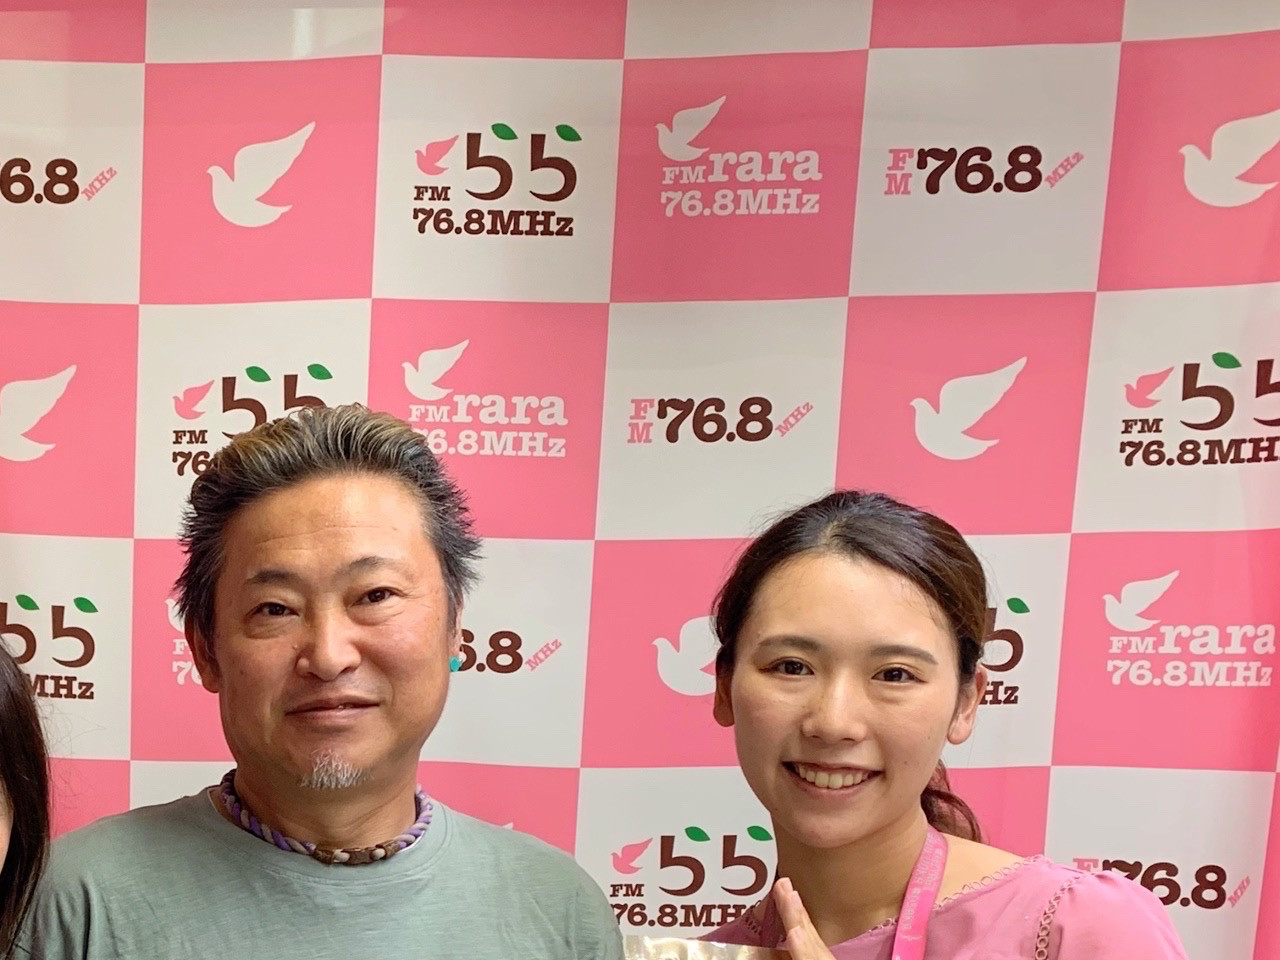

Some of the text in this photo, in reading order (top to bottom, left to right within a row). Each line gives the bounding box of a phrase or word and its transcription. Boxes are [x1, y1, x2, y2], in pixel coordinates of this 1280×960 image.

[662, 148, 823, 184] FM rara
[916, 144, 1043, 195] 76.8
[1043, 150, 1084, 188] MHz
[80, 165, 117, 202] MHz
[413, 185, 451, 202] FM
[660, 188, 821, 218] 76.8MHz
[412, 207, 574, 238] 76.8MHz
[408, 394, 568, 426] FM rara
[656, 396, 773, 444] 76.8
[774, 401, 814, 438] MHz
[172, 430, 208, 444] FM
[1121, 418, 1163, 434] FM
[413, 428, 566, 457] 6.8MHz
[1120, 436, 1280, 466] 76.8MH
[457, 629, 562, 673] 6.8 MHz
[1108, 621, 1277, 656] FM rara
[1106, 660, 1273, 687] 76.8MHz
[610, 884, 644, 897] FM
[611, 903, 755, 927] 76.8MH
